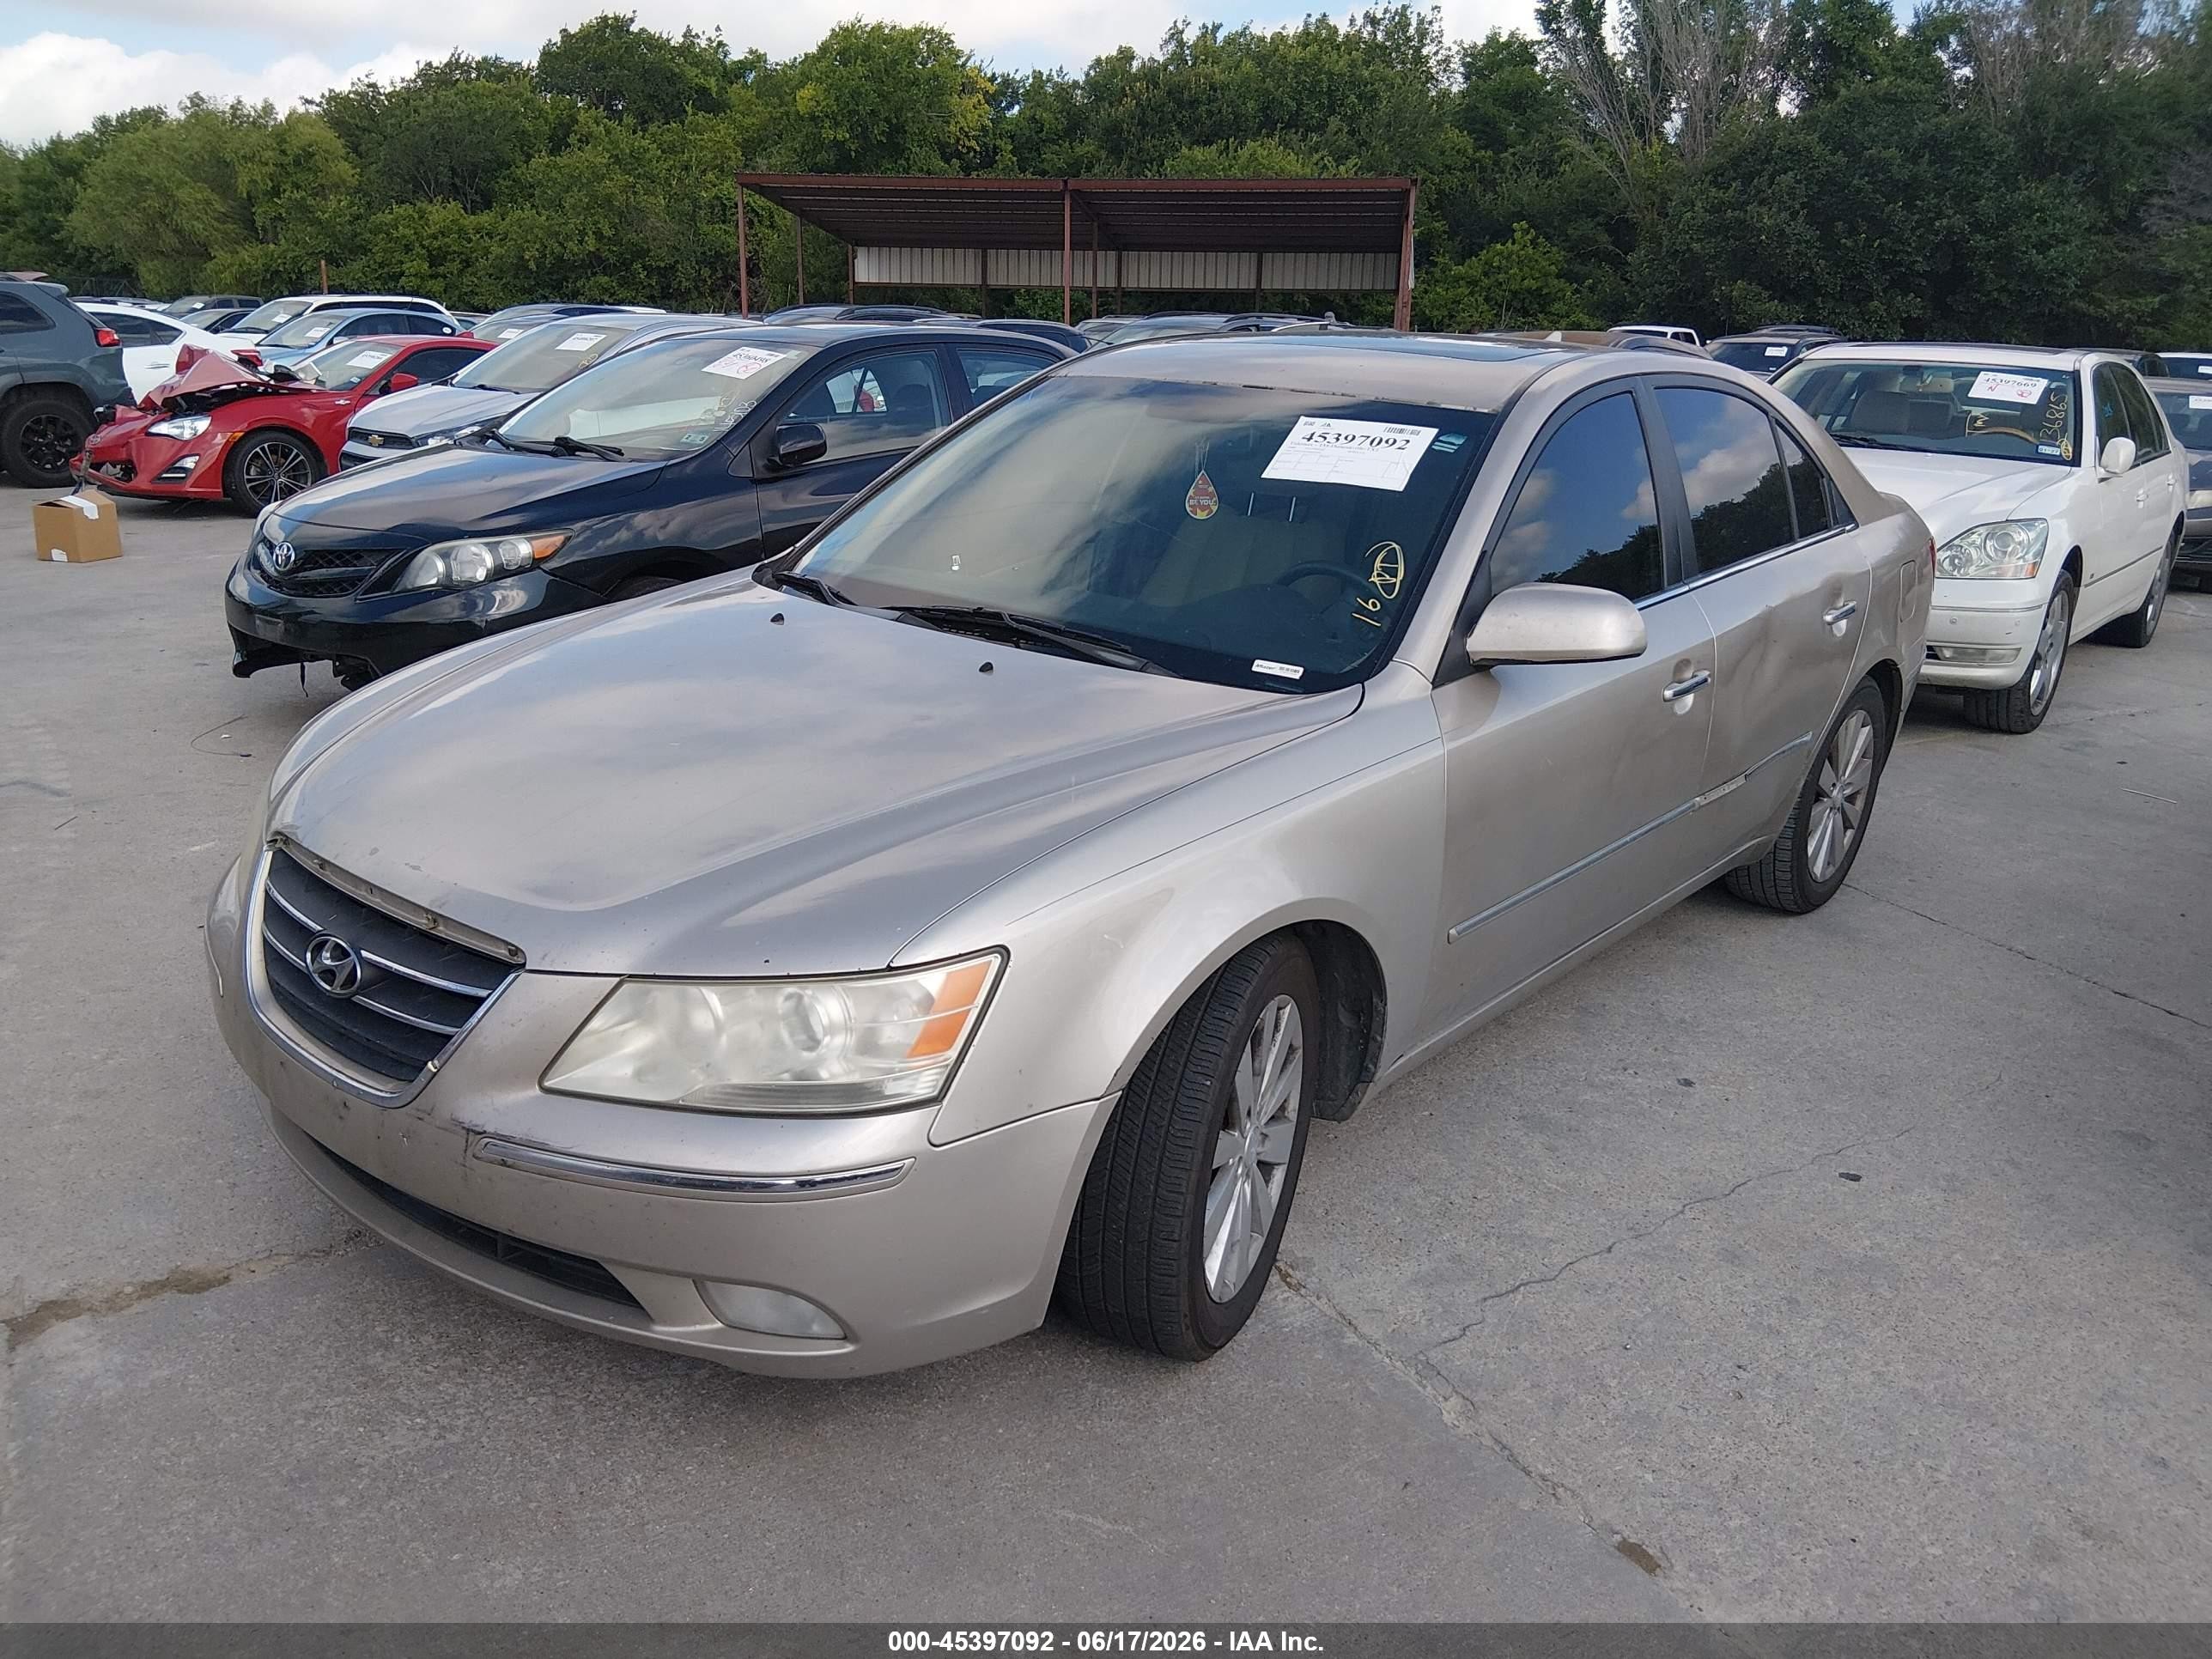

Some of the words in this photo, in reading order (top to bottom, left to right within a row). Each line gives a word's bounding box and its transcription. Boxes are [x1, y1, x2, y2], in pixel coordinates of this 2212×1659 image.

[2039, 392, 2068, 440] 36865
[1302, 431, 1411, 451] 45397092
[1352, 598, 1381, 627] 16
